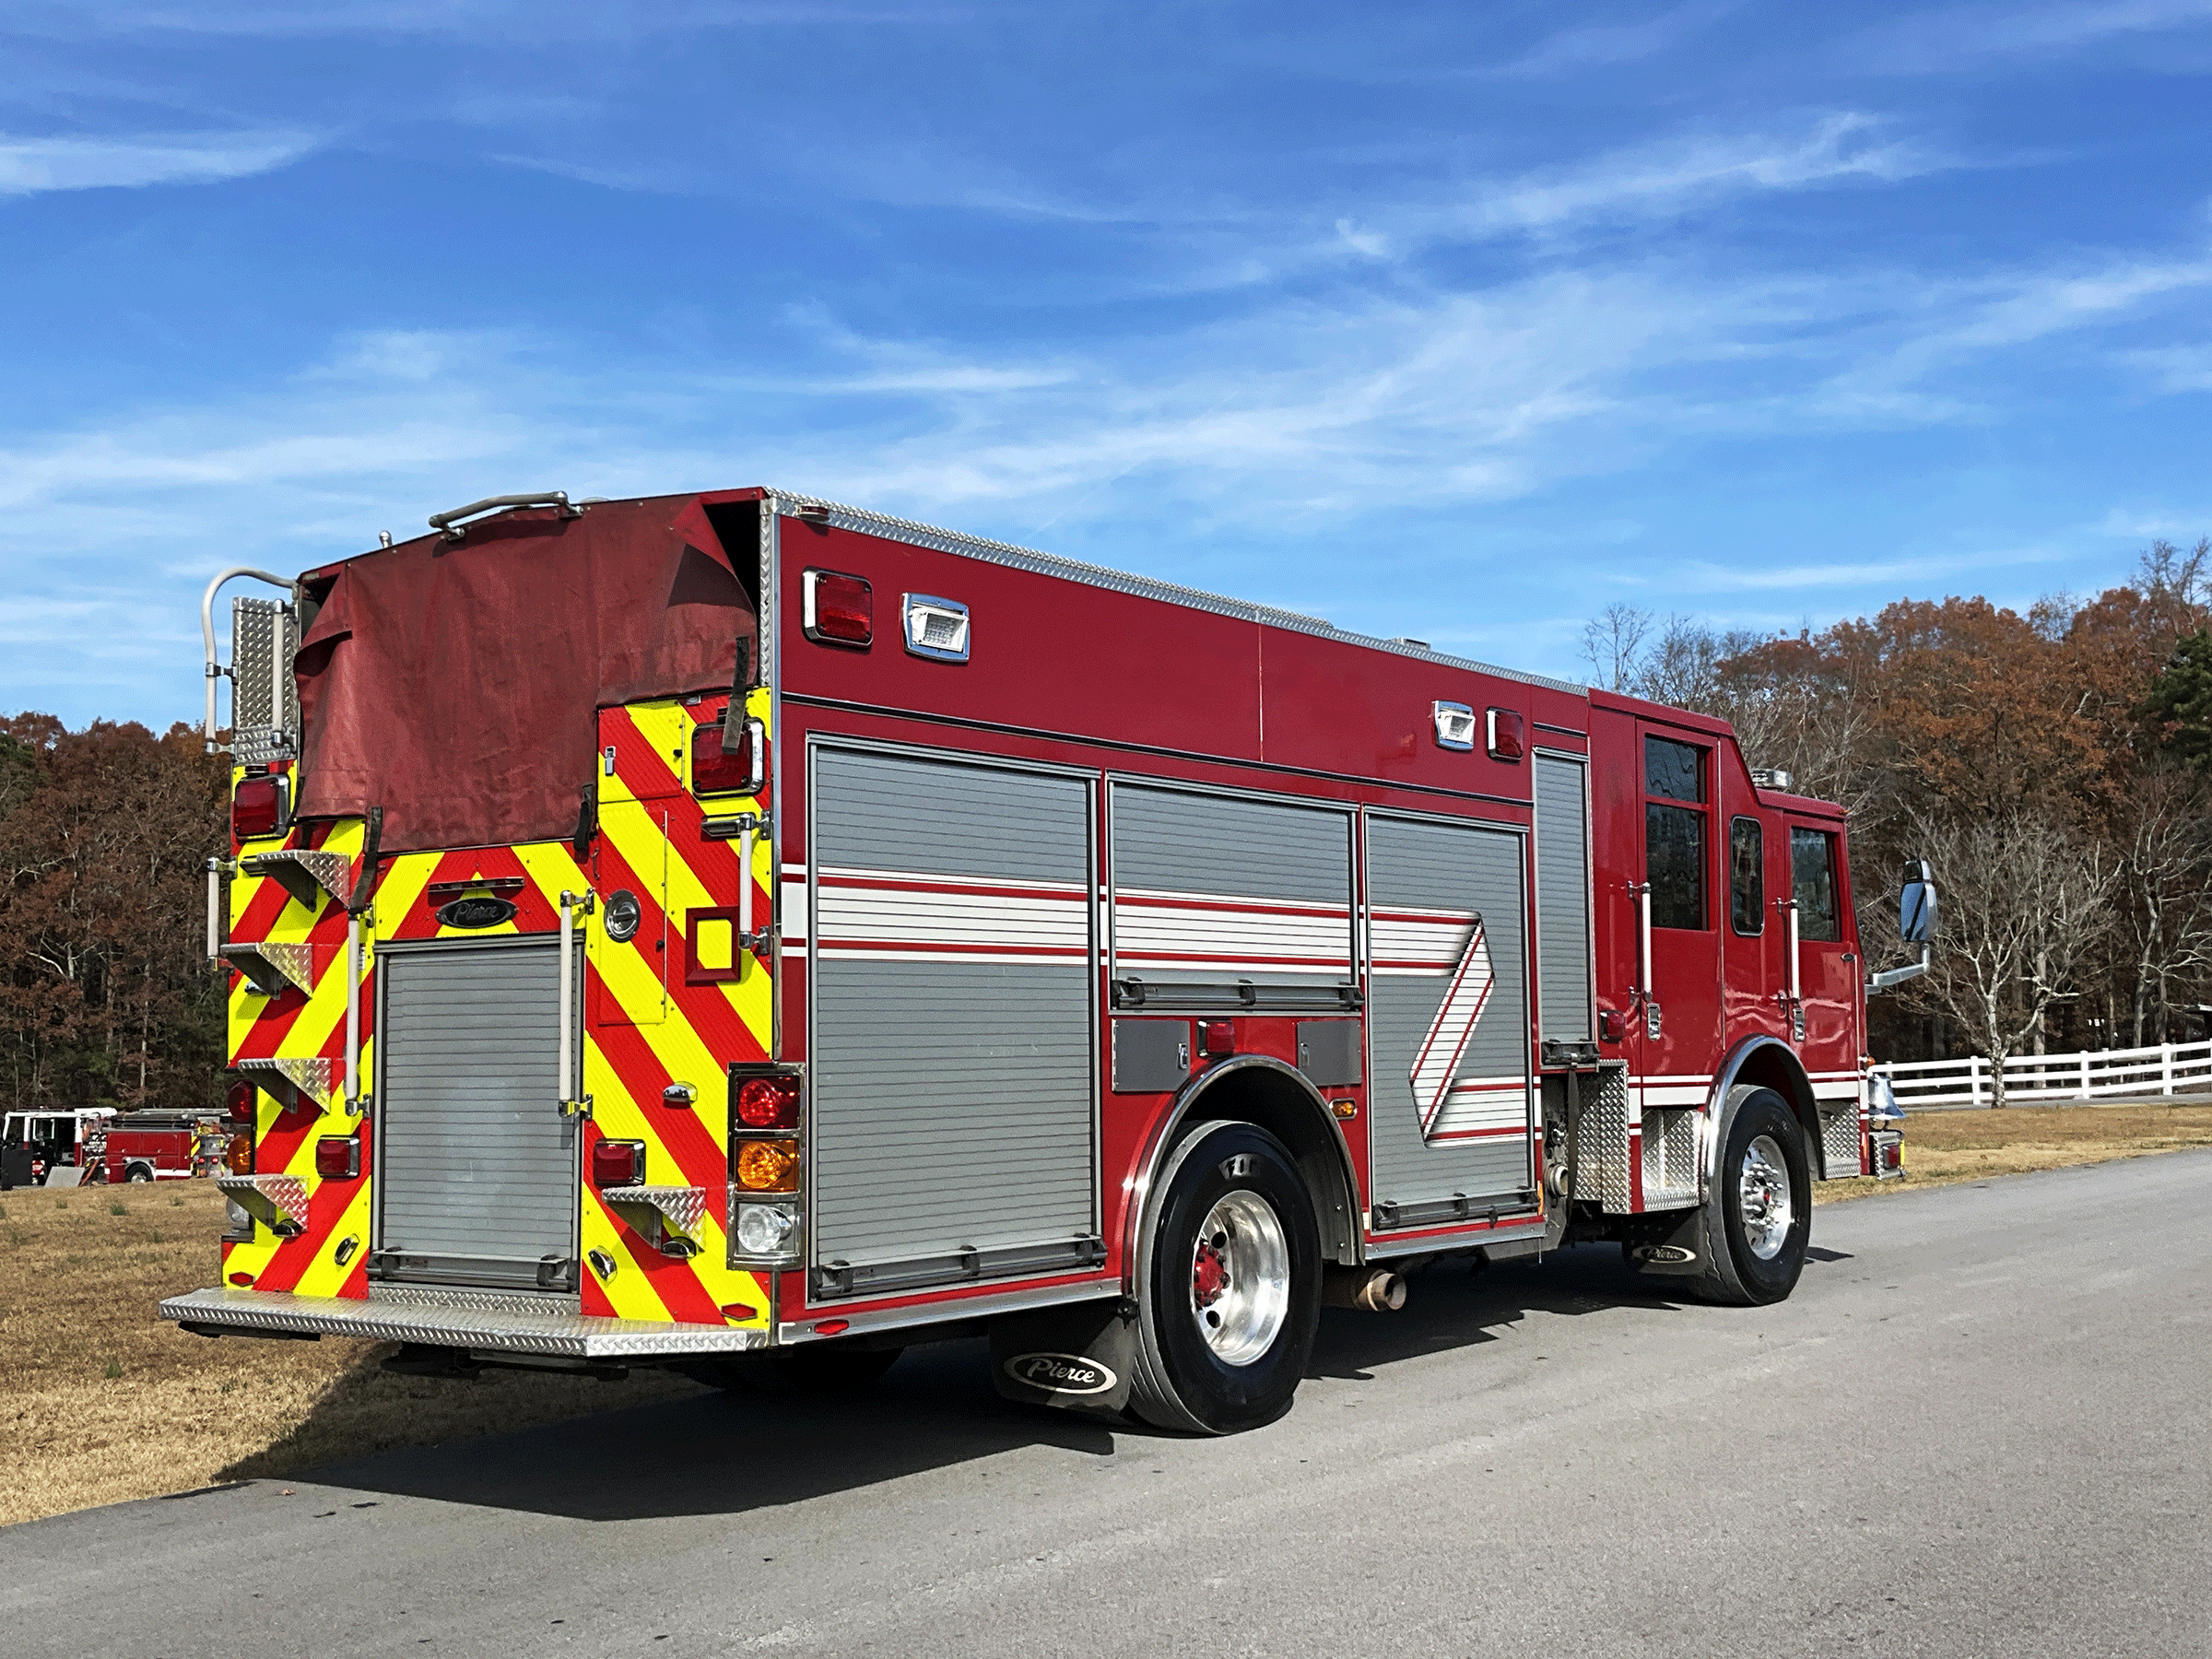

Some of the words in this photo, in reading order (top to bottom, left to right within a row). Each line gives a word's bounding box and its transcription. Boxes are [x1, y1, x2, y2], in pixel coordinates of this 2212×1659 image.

[453, 901, 499, 924] Pierce
[1647, 1247, 1681, 1259] Pierce
[1027, 1358, 1095, 1382] Pierce
